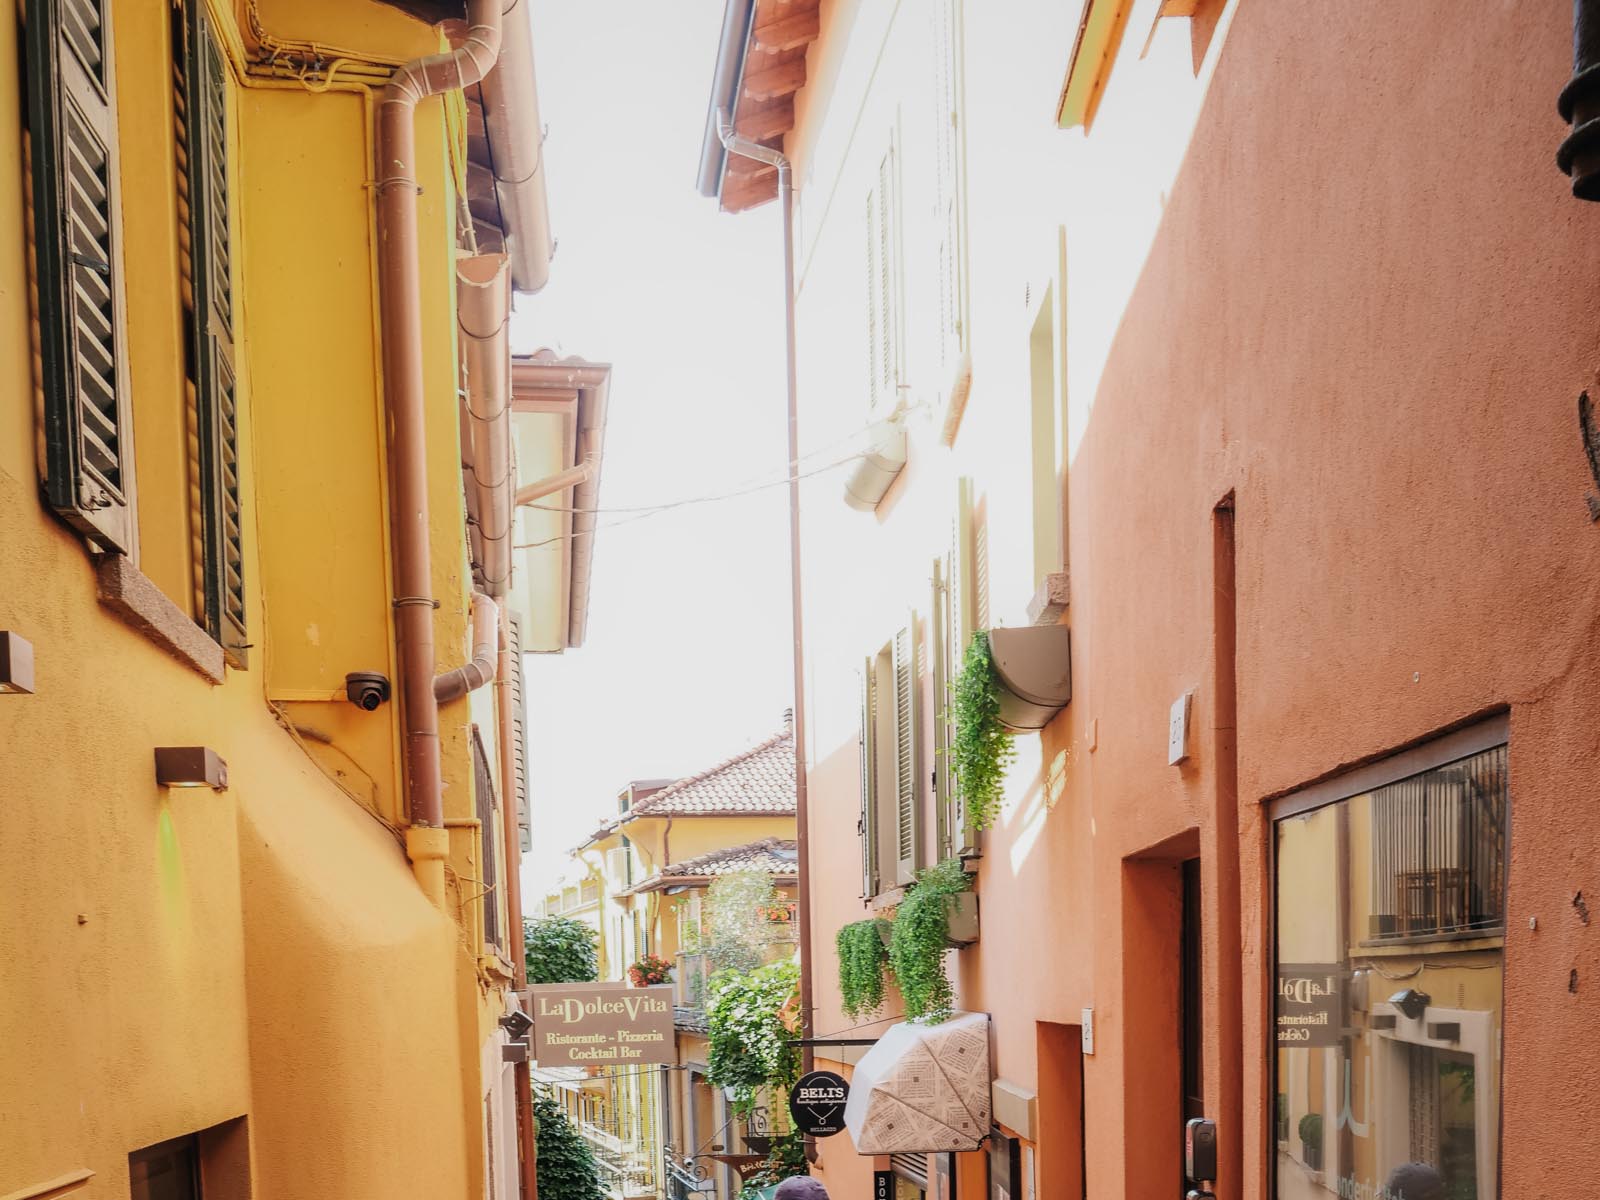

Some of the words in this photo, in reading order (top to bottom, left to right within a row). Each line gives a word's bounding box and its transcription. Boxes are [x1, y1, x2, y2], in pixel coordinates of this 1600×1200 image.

[546, 1031, 607, 1045] Ristorante
[617, 1029, 664, 1043] Pizzeria
[568, 1047, 618, 1060] Cocktail
[620, 1047, 643, 1058] Bar
